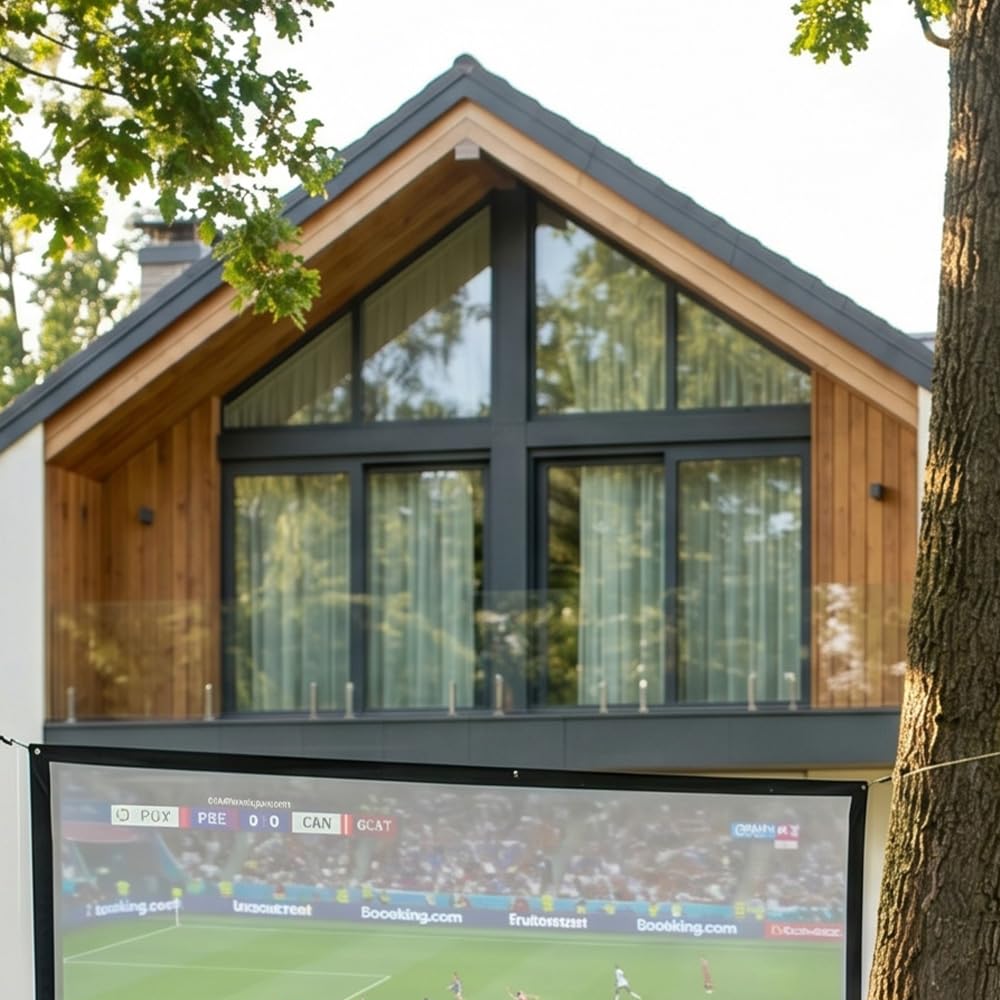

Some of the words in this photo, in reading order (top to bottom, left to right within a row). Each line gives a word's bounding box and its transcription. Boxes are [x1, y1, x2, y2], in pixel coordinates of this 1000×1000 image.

[248, 814, 259, 827] 0
[269, 815, 280, 828] 0
[302, 816, 332, 830] CAN
